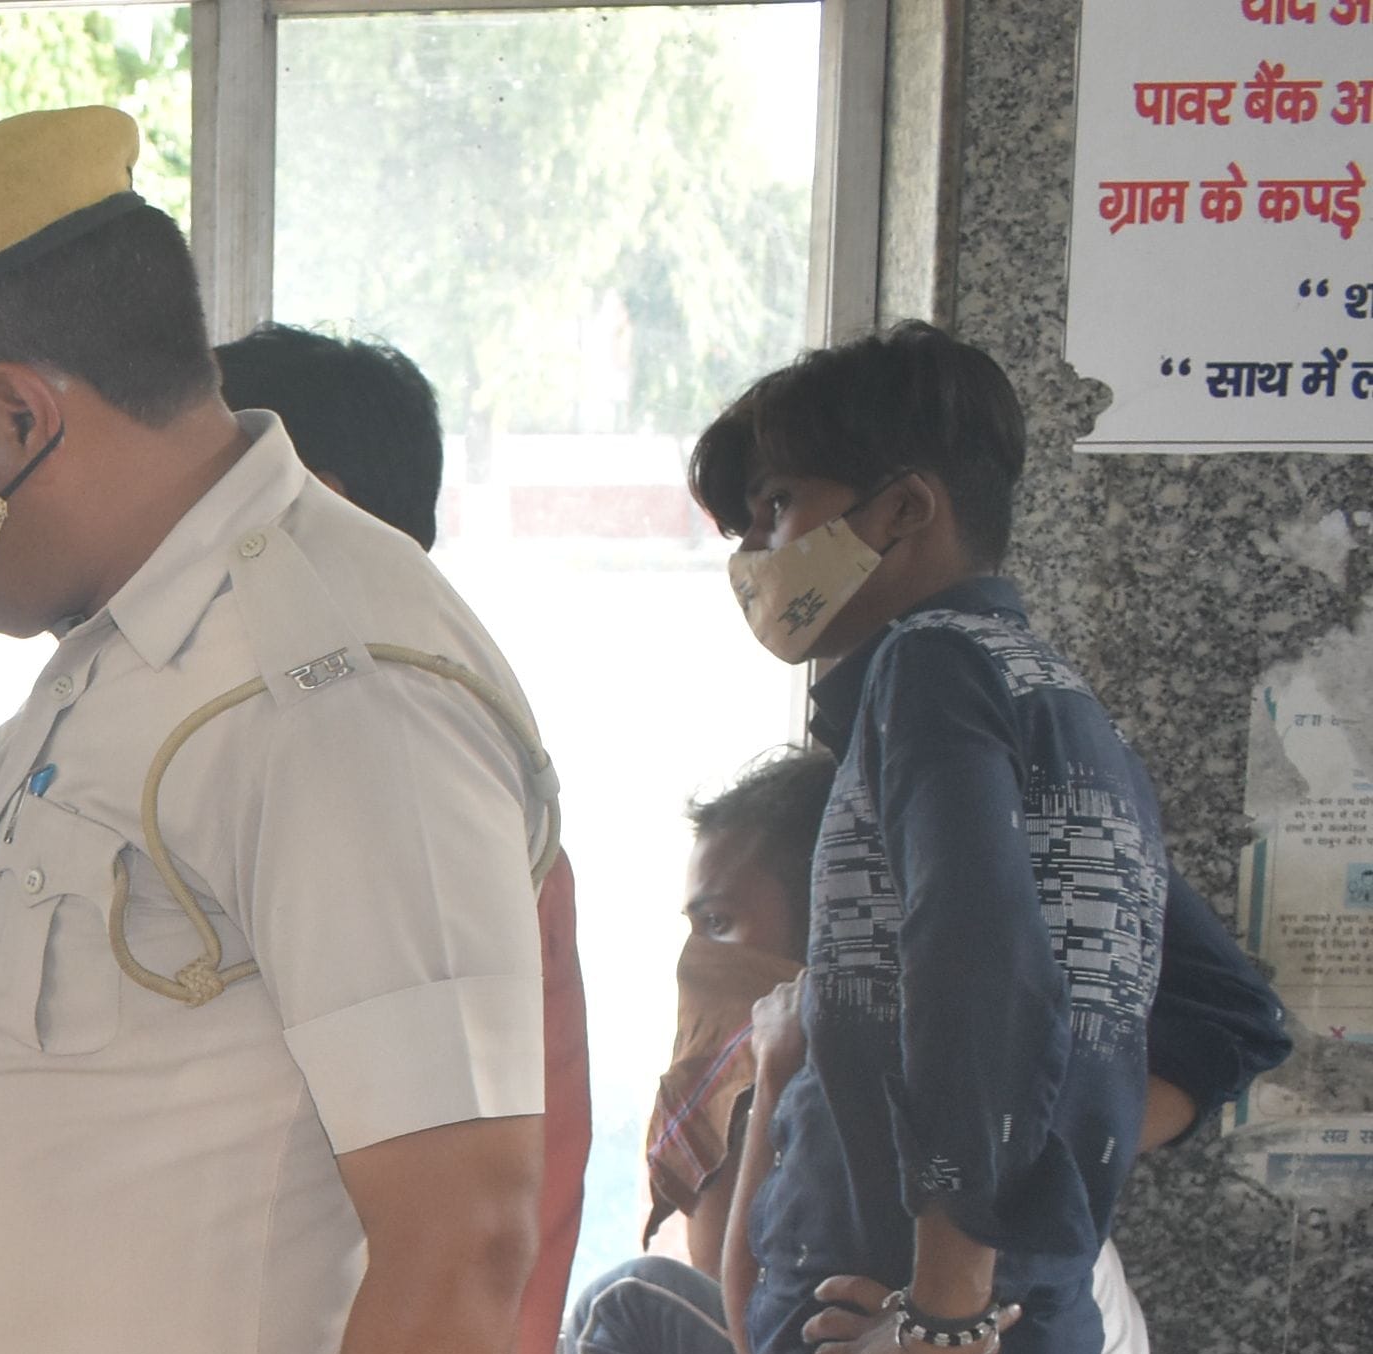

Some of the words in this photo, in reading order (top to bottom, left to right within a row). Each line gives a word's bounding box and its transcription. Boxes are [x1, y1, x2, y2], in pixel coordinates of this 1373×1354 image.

[1330, 0, 1373, 26] अ
[1134, 81, 1237, 126] पावर
[1244, 60, 1323, 124] बैंक
[1331, 80, 1373, 125] अ
[1099, 181, 1190, 235] ग्राम
[1200, 162, 1248, 224] के
[1257, 161, 1366, 240] कपड़े
[1206, 362, 1293, 399] साथ
[1301, 347, 1348, 397] में
